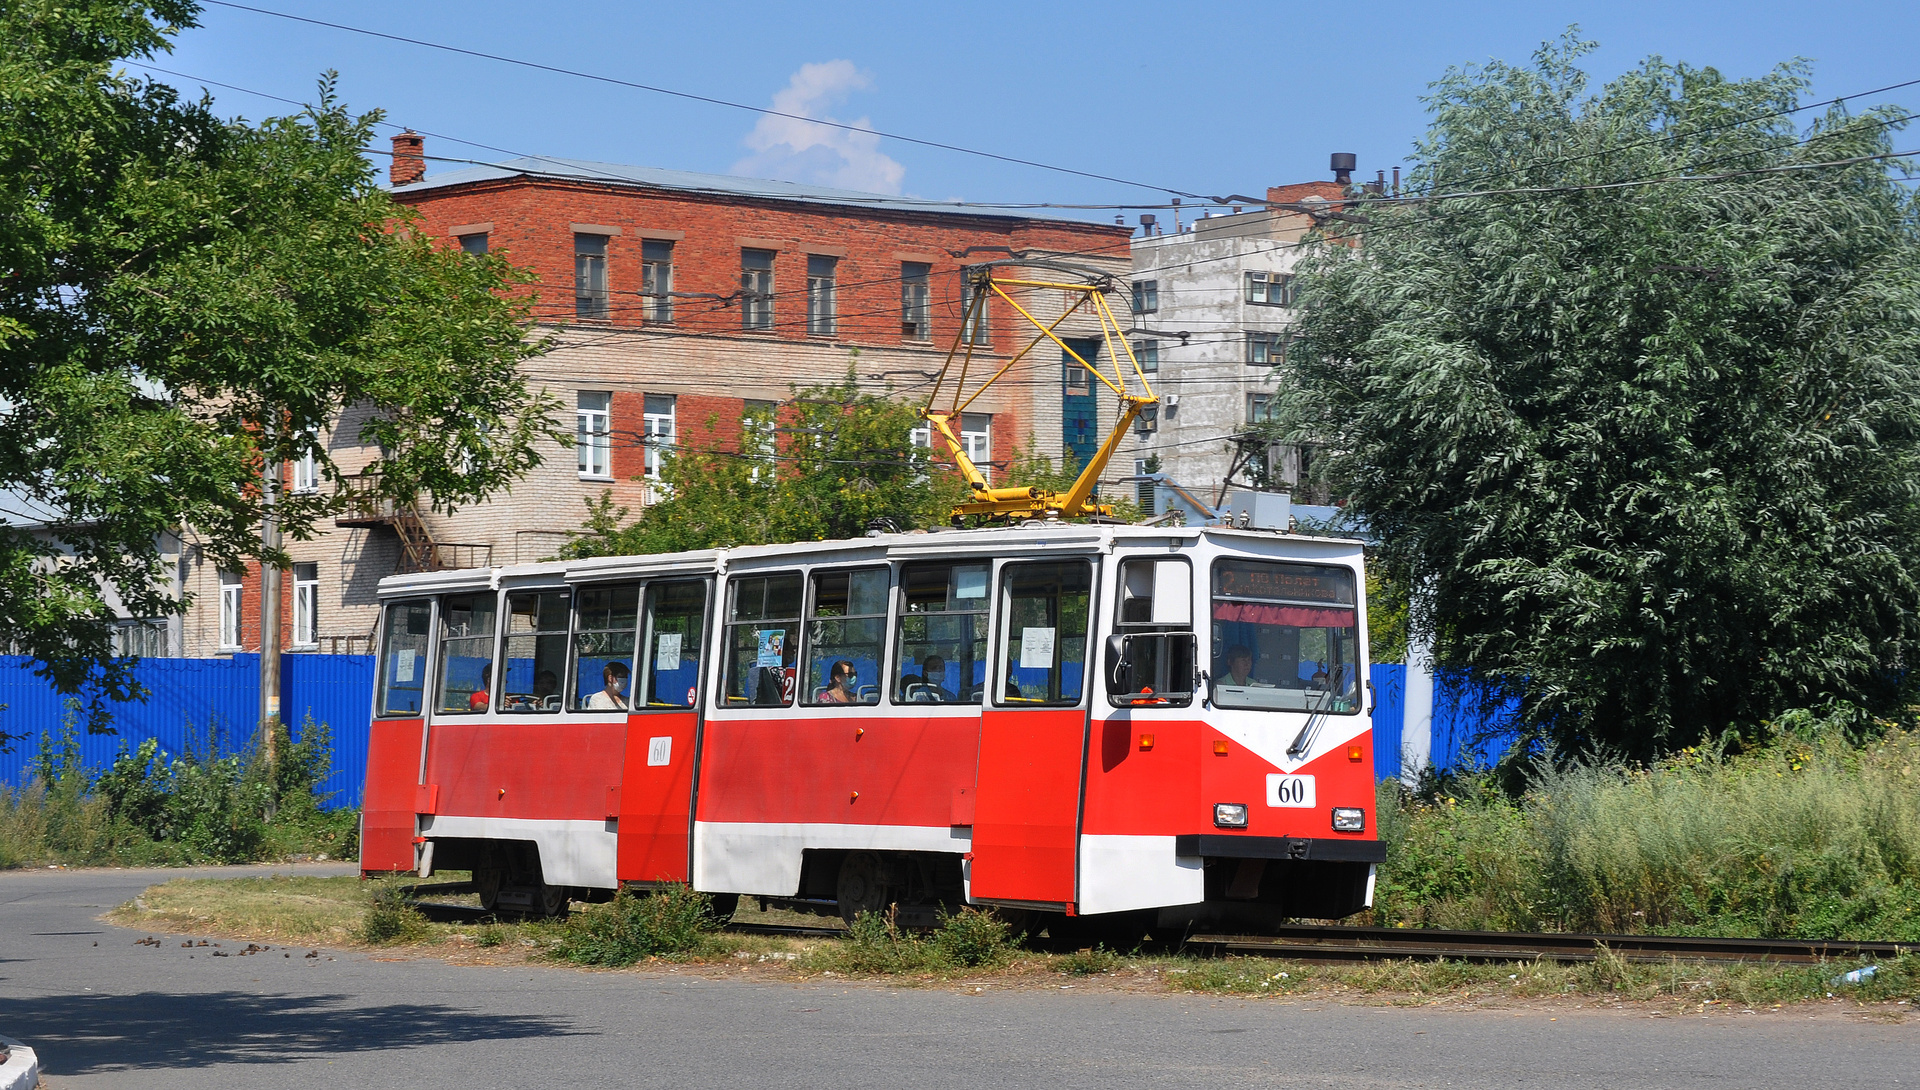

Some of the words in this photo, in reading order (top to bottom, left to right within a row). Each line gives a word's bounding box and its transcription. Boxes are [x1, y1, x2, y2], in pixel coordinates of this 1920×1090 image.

[1223, 571, 1235, 594] 2
[784, 677, 794, 701] 2
[653, 740, 666, 762] 60
[1278, 778, 1304, 803] 60
